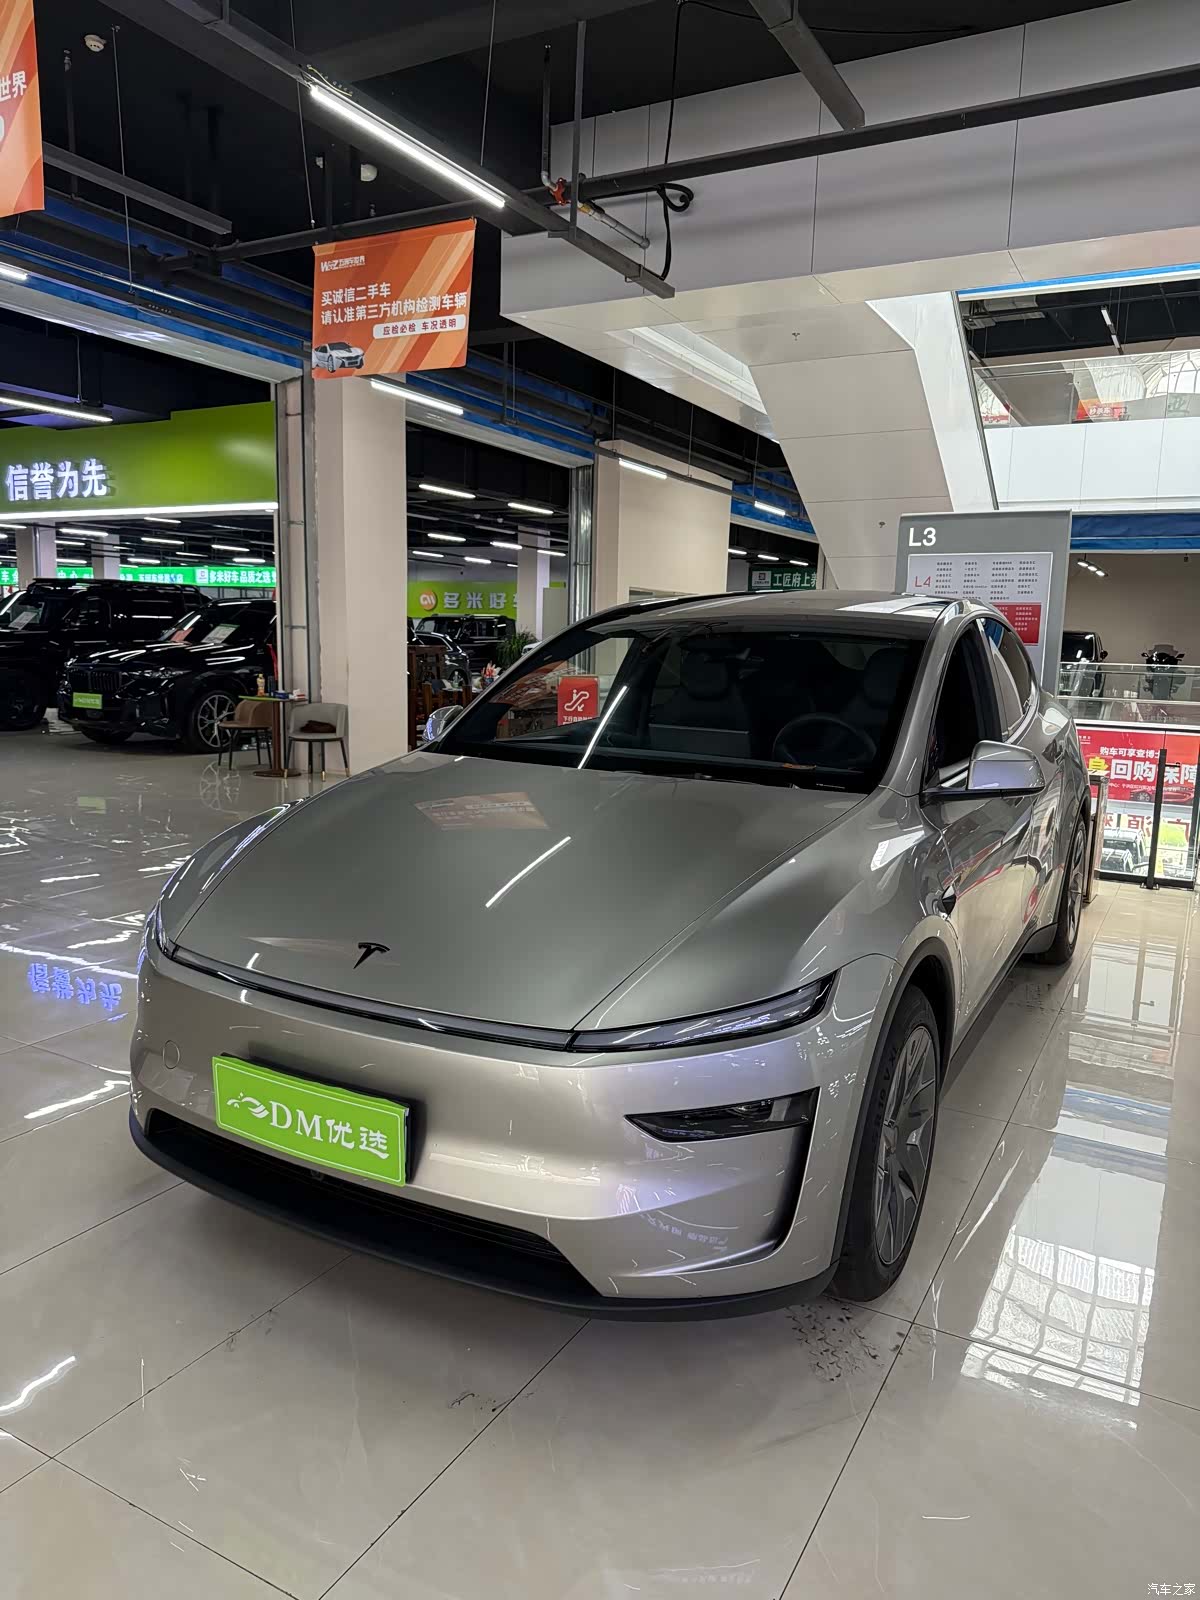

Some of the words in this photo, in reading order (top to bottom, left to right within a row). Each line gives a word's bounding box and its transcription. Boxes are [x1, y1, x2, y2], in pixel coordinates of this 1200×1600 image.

[321, 282, 391, 307] 买诚信二手车
[320, 291, 468, 326] 请认准第三方机构检测车辆
[383, 323, 416, 336] 应检必检
[421, 318, 457, 331] 车况透明
[5, 458, 107, 501] 信誉为先
[908, 527, 937, 547] L3
[209, 570, 240, 584] 多米好车
[240, 570, 271, 584] 品质之选
[914, 576, 932, 588] L4
